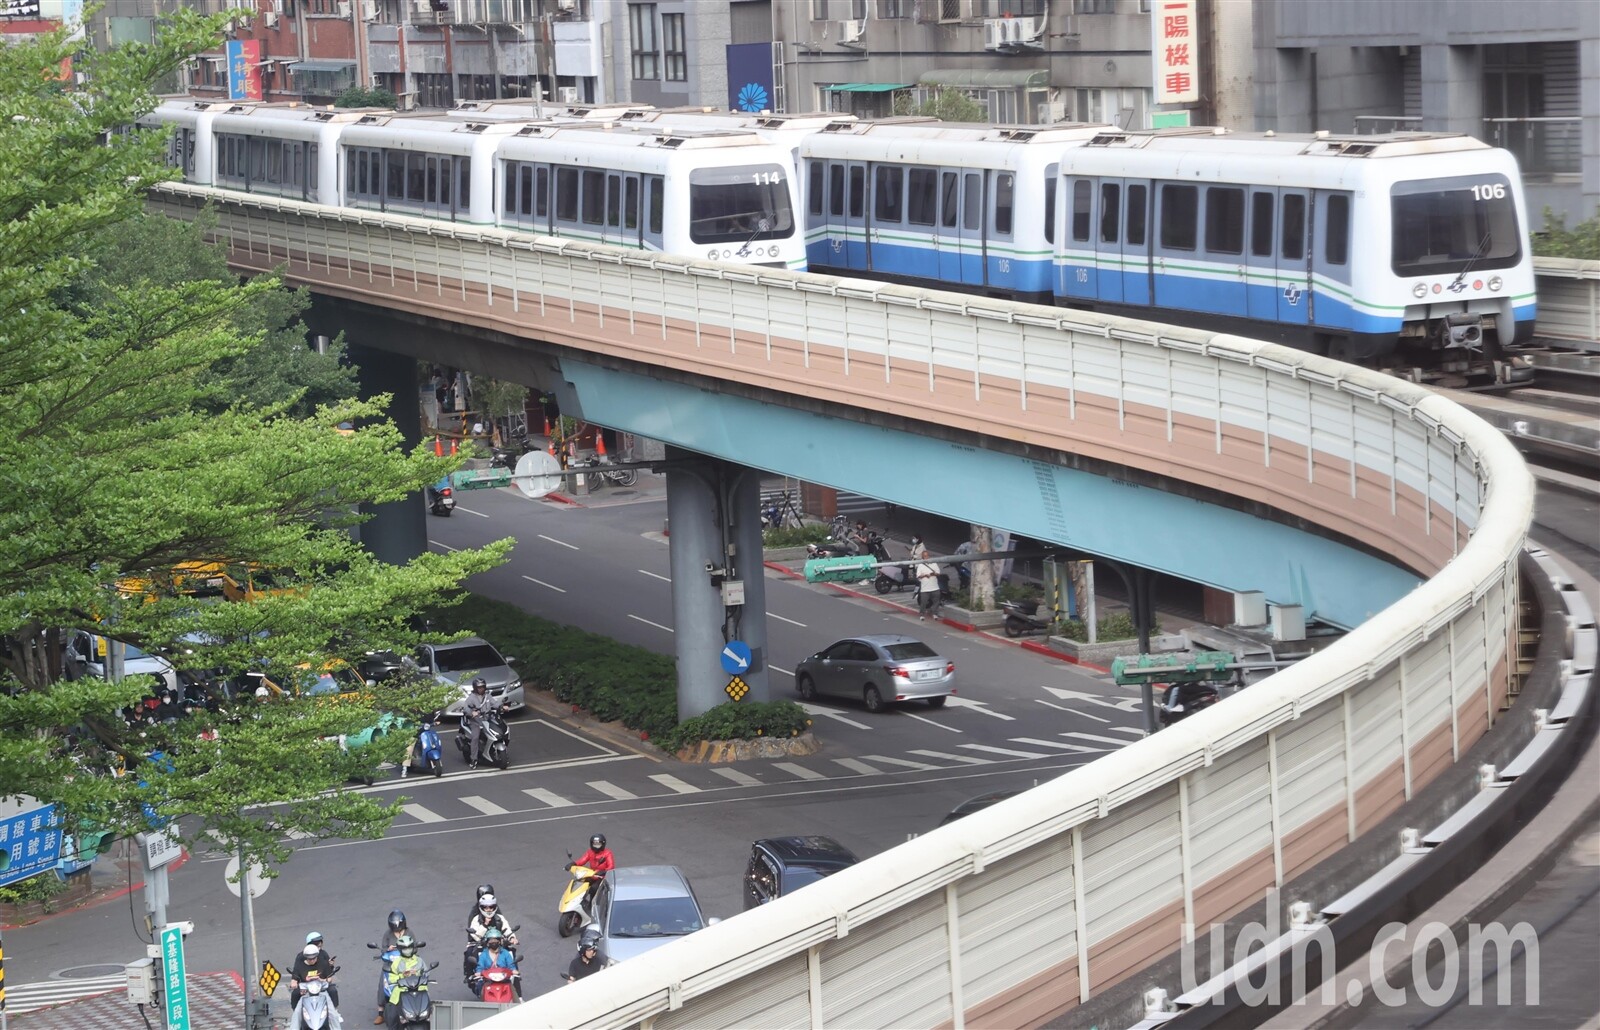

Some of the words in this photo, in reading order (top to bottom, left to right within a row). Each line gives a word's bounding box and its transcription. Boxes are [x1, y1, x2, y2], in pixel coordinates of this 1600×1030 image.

[234, 44, 257, 99] 上特服
[752, 172, 779, 185] 114
[1471, 183, 1505, 201] 106
[998, 258, 1010, 274] 106
[1075, 268, 1088, 283] 106
[167, 941, 183, 1020] 基隆路二段
